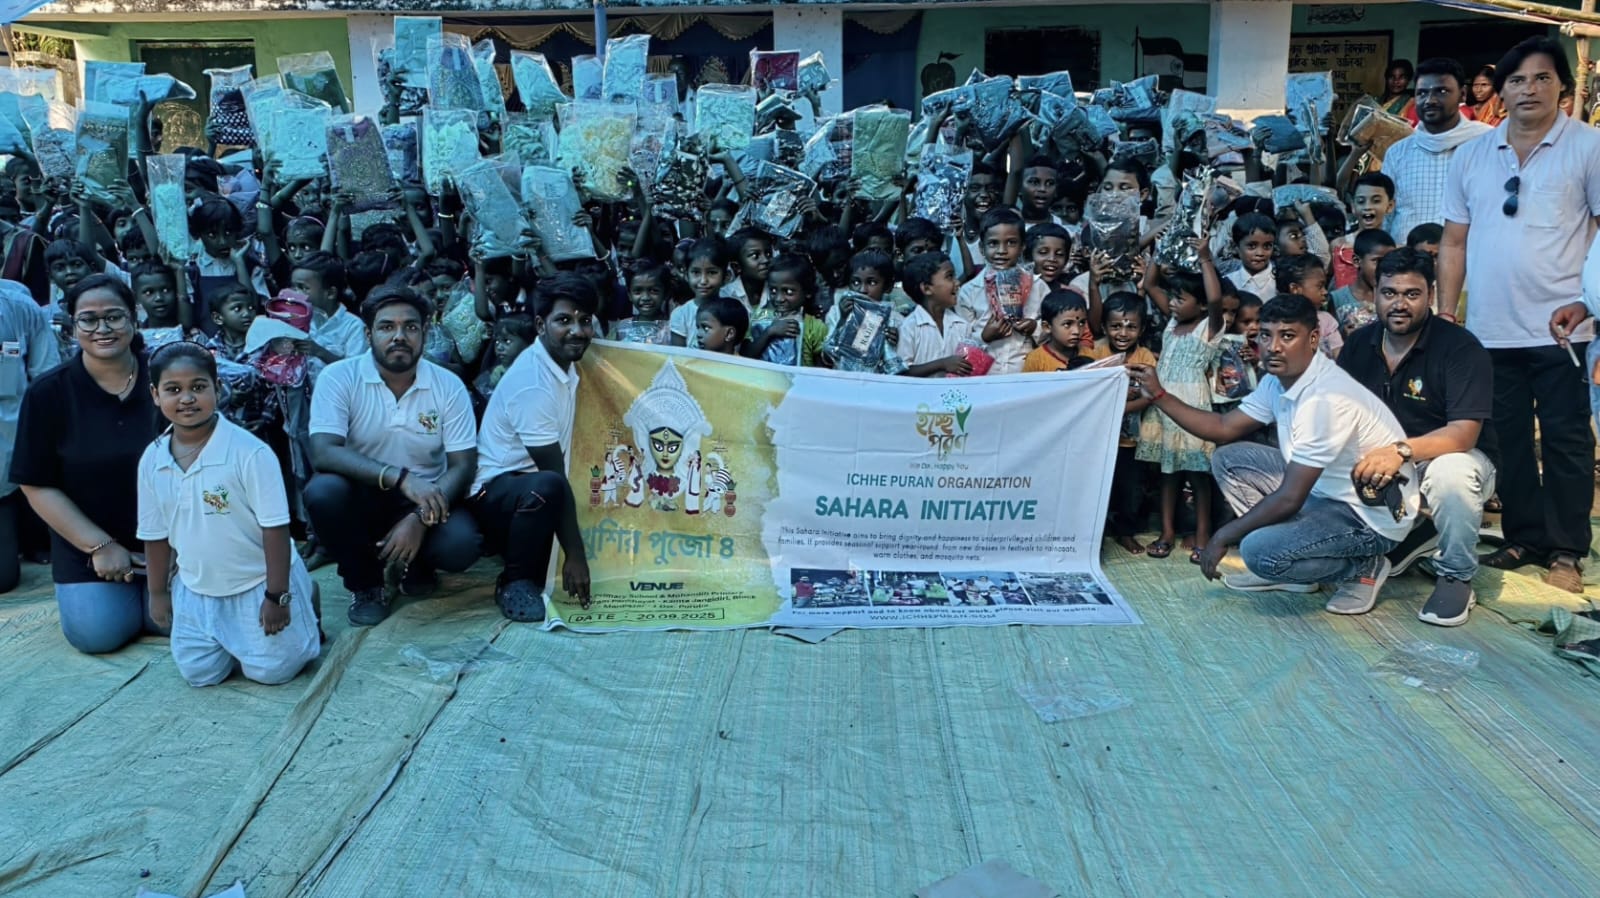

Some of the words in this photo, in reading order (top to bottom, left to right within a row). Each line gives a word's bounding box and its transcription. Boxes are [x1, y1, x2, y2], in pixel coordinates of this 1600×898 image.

[847, 473, 887, 487] ICHHE
[890, 475, 934, 488] PURAN
[937, 476, 1032, 489] ORGANIZATION
[815, 495, 909, 520] SAHARA
[920, 499, 1038, 521] INITIATIVE
[781, 526, 794, 535] This
[796, 527, 820, 536] Sahara
[821, 528, 851, 538] Initiative
[853, 531, 868, 539] aims
[870, 532, 878, 540] to
[879, 532, 897, 541] bring
[938, 533, 972, 543] happiness
[981, 535, 1033, 544] underprivileged
[1034, 532, 1060, 543] children
[1062, 533, 1076, 543] and
[648, 531, 714, 565] পুজো
[814, 538, 843, 547] provides
[844, 540, 874, 548] seasonal
[875, 541, 900, 550] support
[942, 543, 957, 551] from
[974, 544, 998, 552] dresses
[1007, 544, 1034, 552] festivals
[920, 551, 934, 560] and
[934, 553, 964, 562] mosquito
[629, 581, 685, 591] VENUE
[575, 612, 615, 622] DATE
